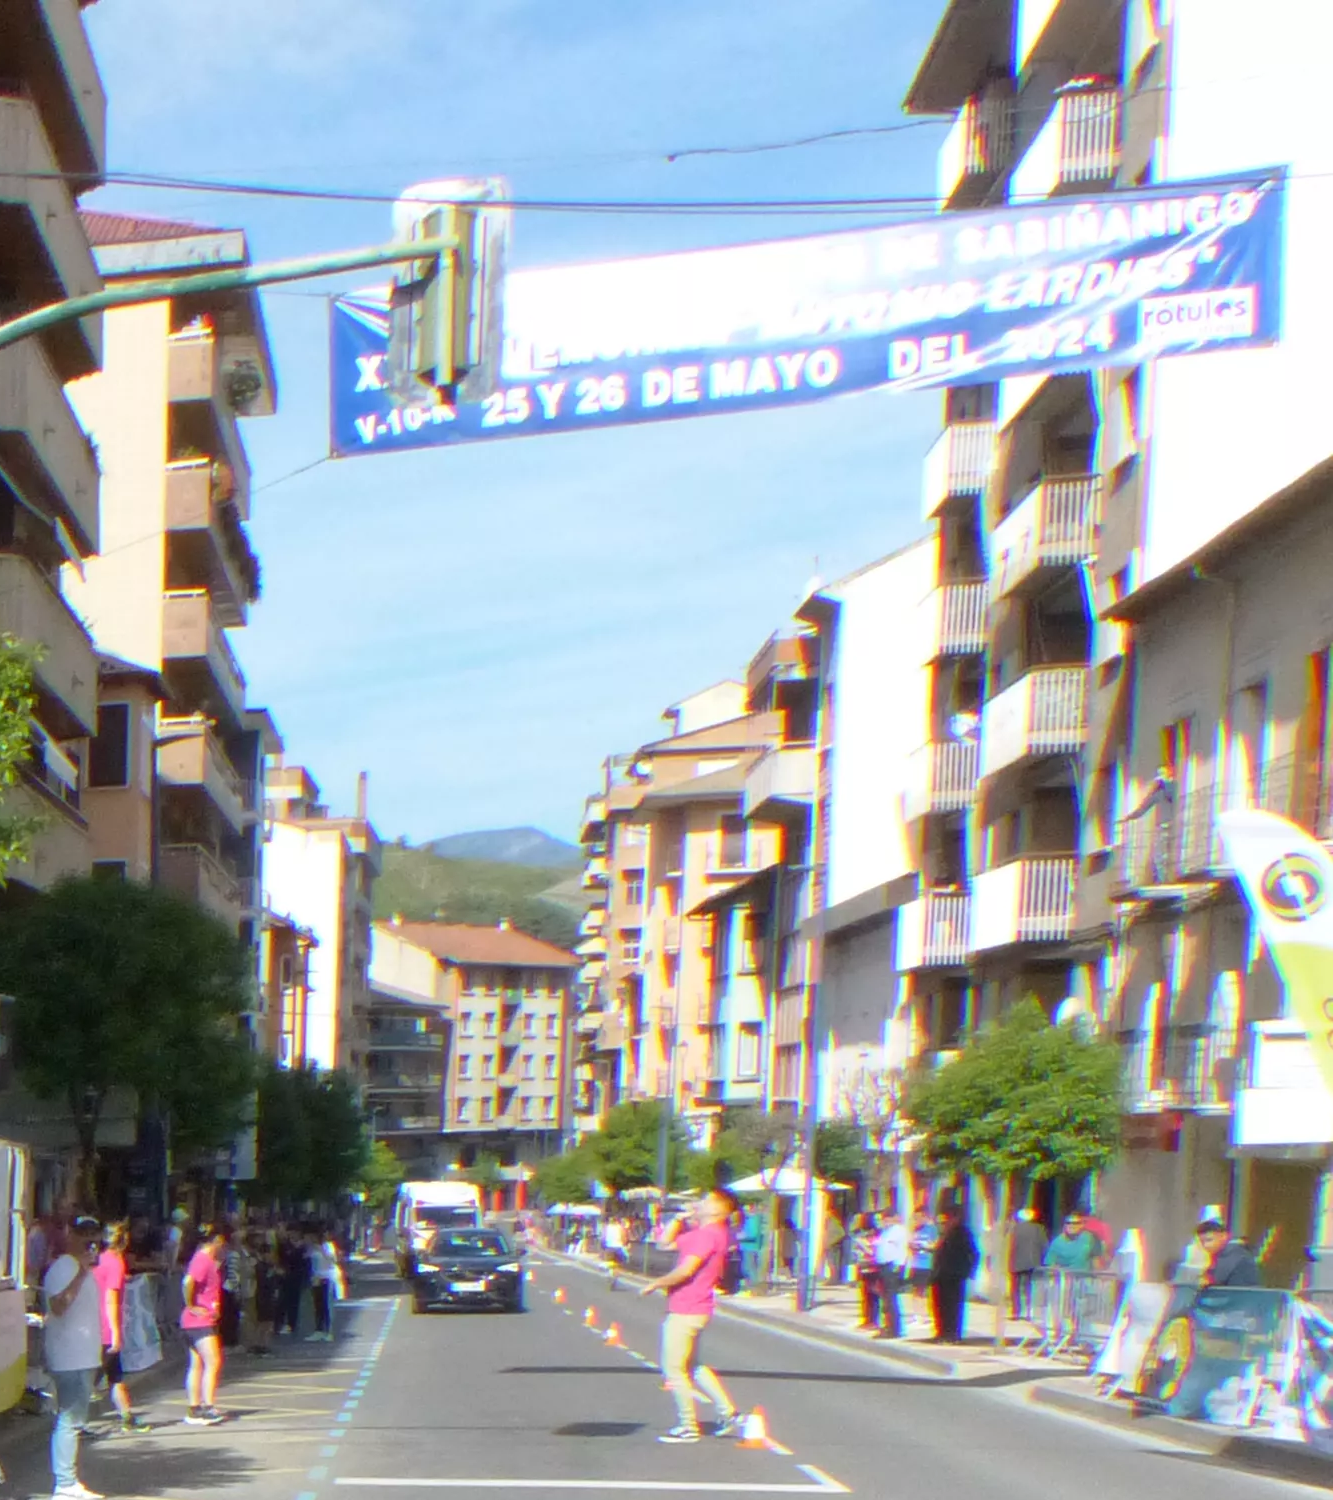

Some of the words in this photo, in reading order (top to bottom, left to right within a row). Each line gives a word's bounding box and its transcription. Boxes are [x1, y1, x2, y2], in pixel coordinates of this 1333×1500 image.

[480, 388, 531, 429] 25
[535, 382, 568, 420] Y
[573, 373, 627, 417] 26
[640, 365, 700, 409] DE
[708, 348, 841, 400] MAYO
[887, 330, 971, 380] DEL
[1000, 315, 1112, 363] 2024
